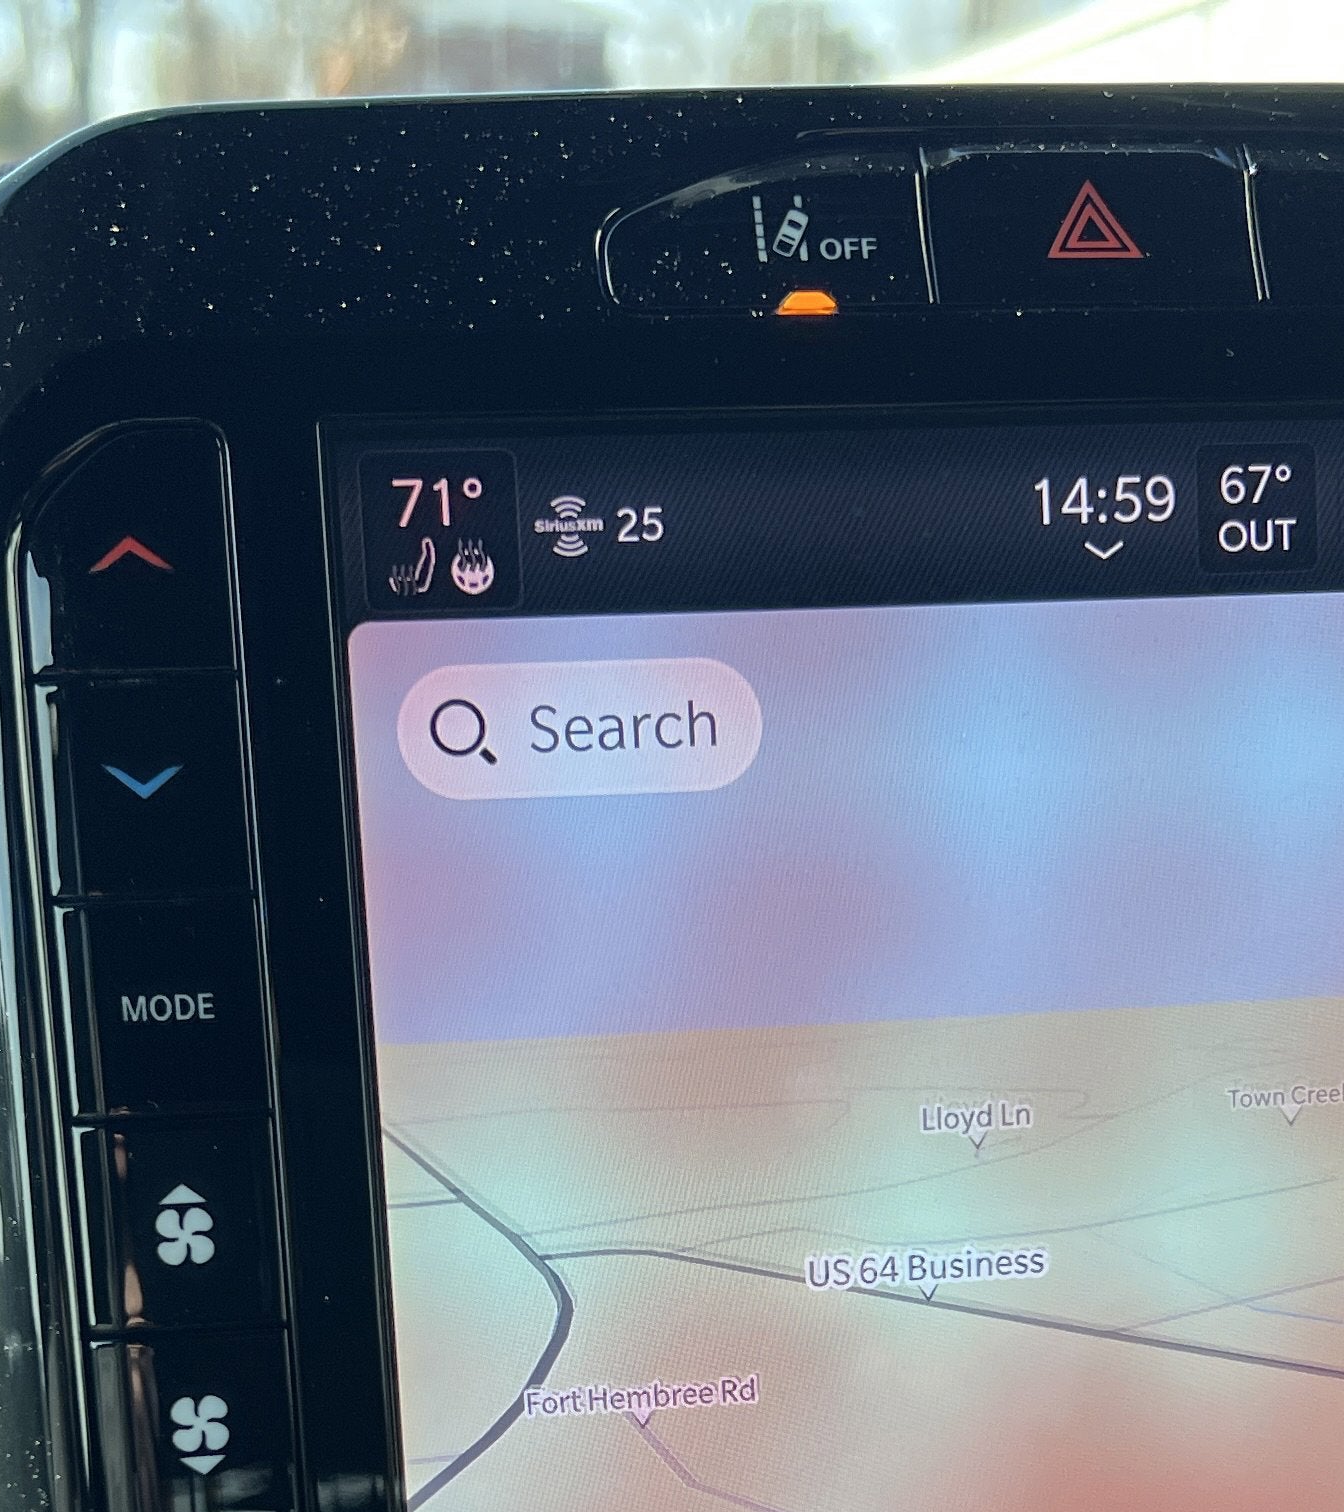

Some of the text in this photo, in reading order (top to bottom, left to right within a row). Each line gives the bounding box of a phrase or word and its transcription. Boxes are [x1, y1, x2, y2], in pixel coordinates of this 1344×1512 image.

[820, 236, 877, 261] OFF
[391, 475, 483, 528] 71°
[1034, 474, 1177, 528] 14:59
[1219, 463, 1293, 507] 67°
[616, 505, 665, 543] 25
[1217, 517, 1297, 553] OUT
[529, 699, 719, 754] Search
[121, 994, 215, 1023] MODE
[1228, 1086, 1285, 1109] Town
[921, 1102, 1032, 1134] Lloyd Ln
[808, 1249, 1046, 1289] US 64 Business
[526, 1377, 757, 1416] Fort Hembree Rd
